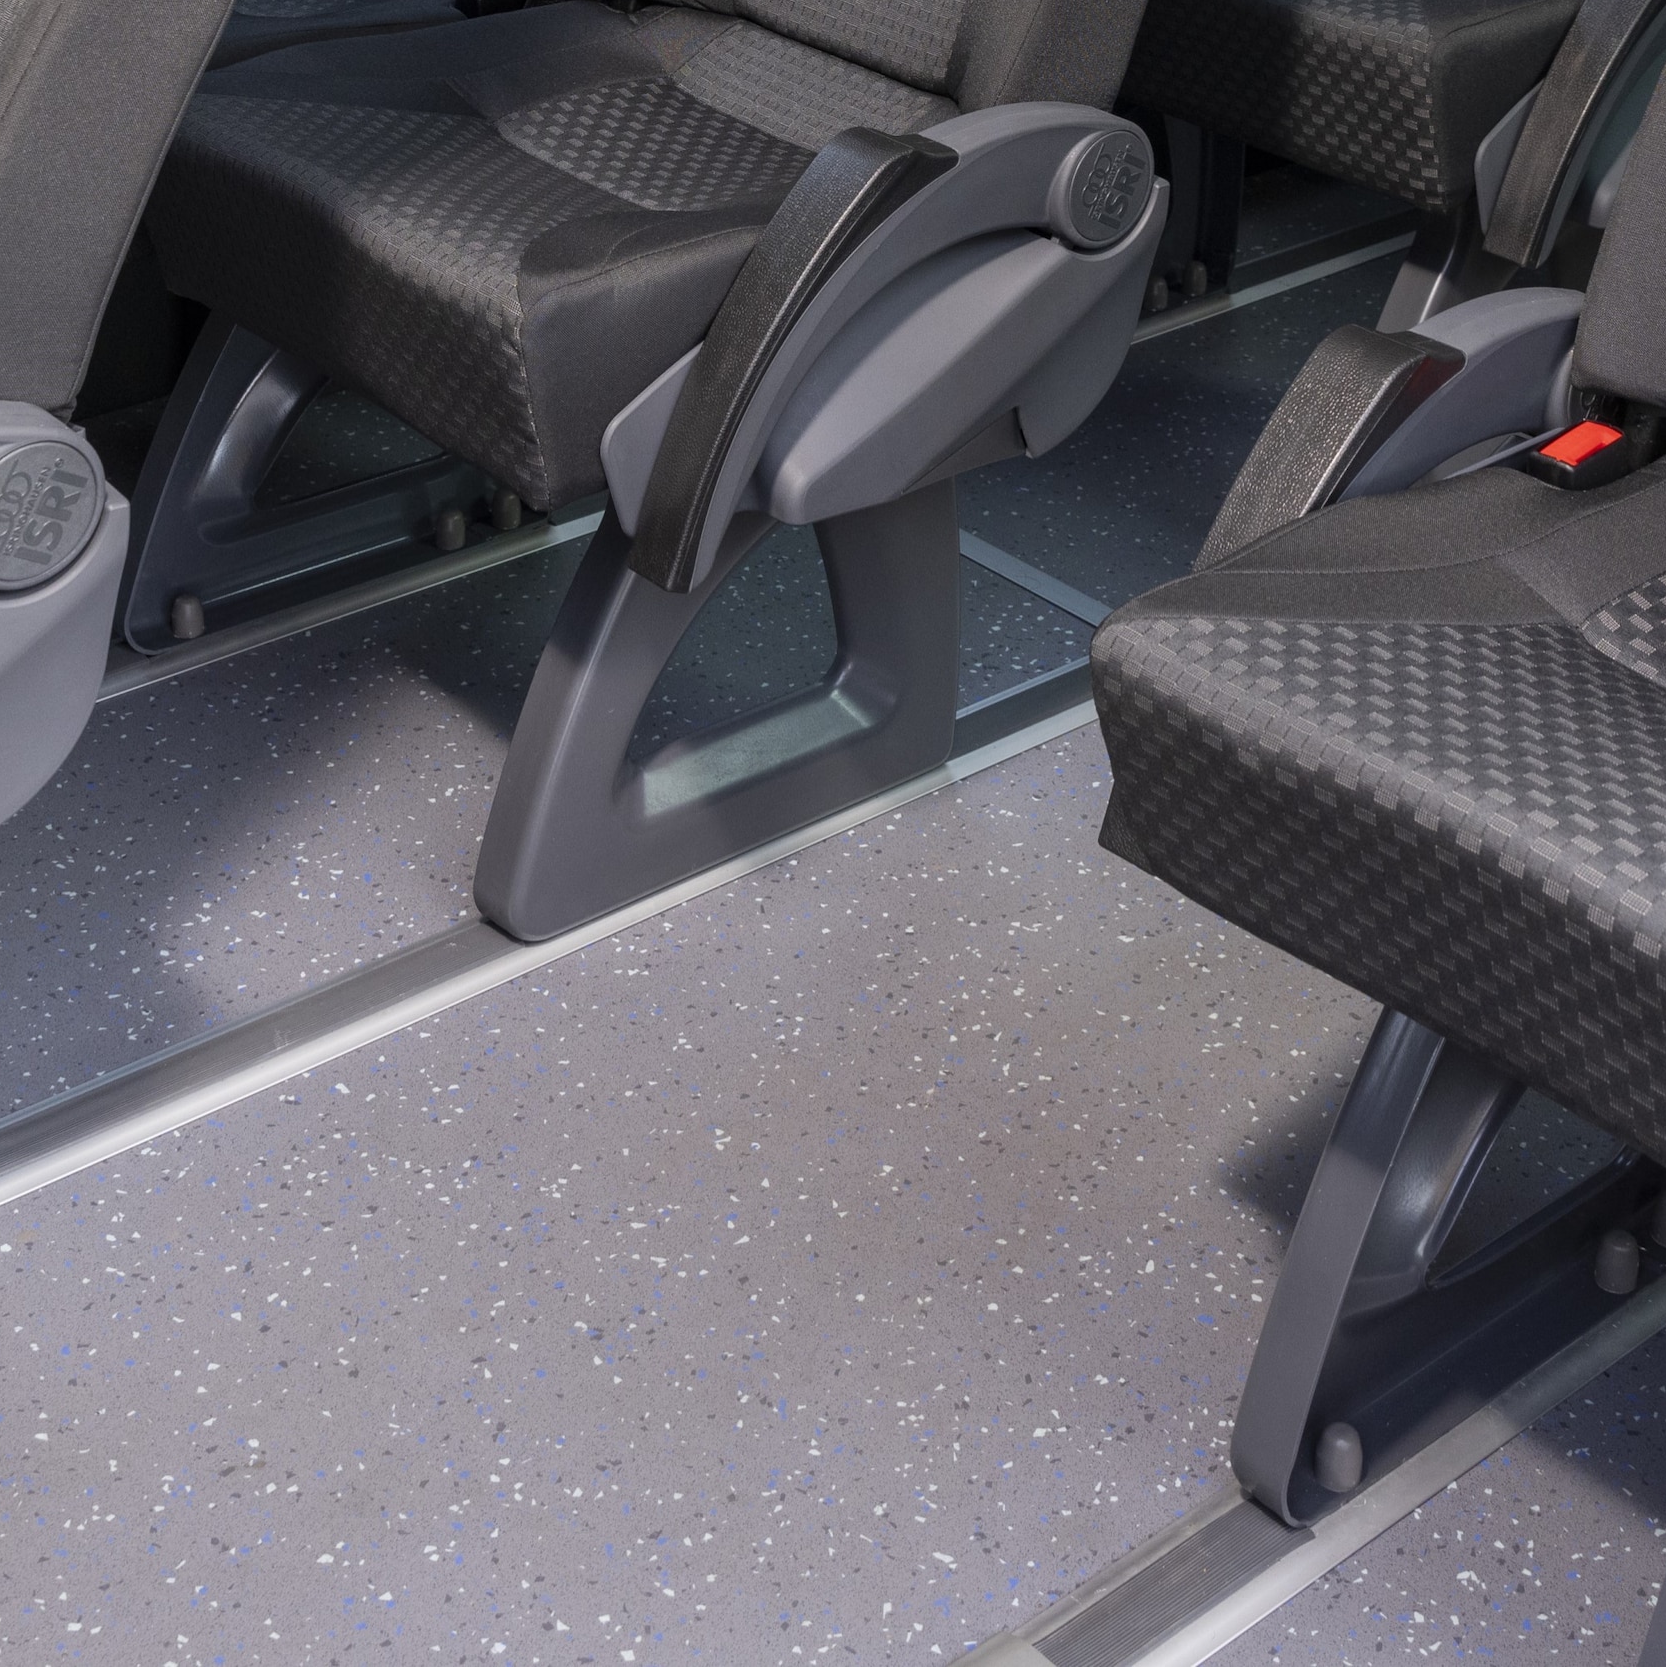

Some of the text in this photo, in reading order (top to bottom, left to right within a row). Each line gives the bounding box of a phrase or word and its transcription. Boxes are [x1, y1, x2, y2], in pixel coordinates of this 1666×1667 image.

[1098, 152, 1147, 230] ISRI
[3, 467, 51, 556] ISRINGHAUSEN
[13, 468, 89, 566] ISRI
